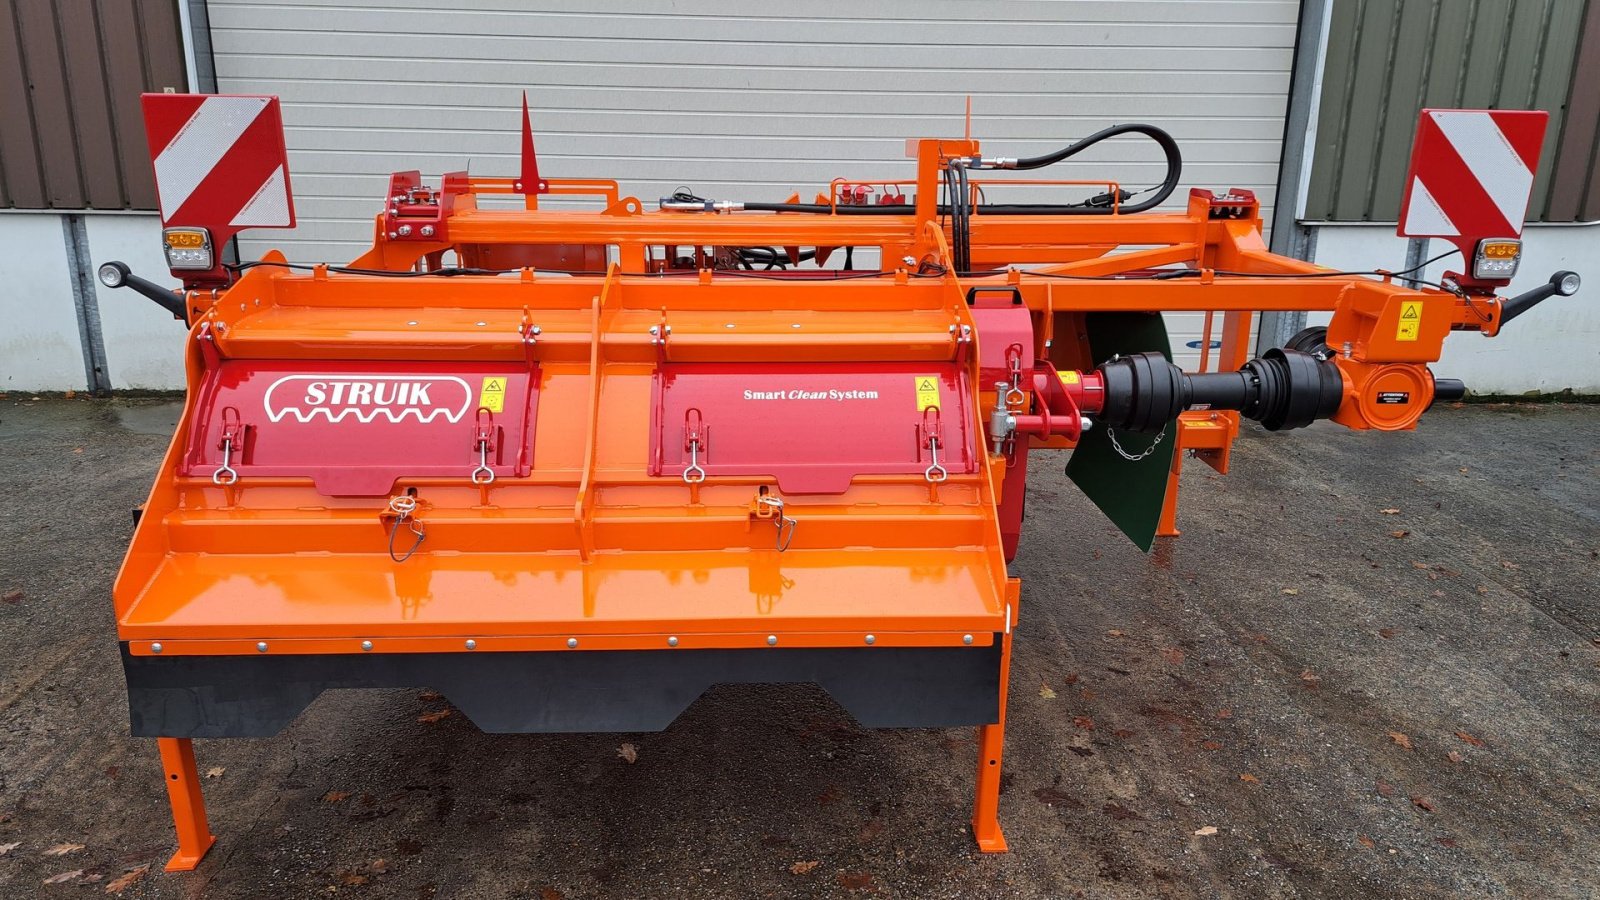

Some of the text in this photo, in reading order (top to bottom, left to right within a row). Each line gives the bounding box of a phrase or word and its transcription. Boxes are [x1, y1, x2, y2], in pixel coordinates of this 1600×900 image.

[304, 382, 432, 406] STRUIK
[743, 389, 879, 402] Smart Clean System
